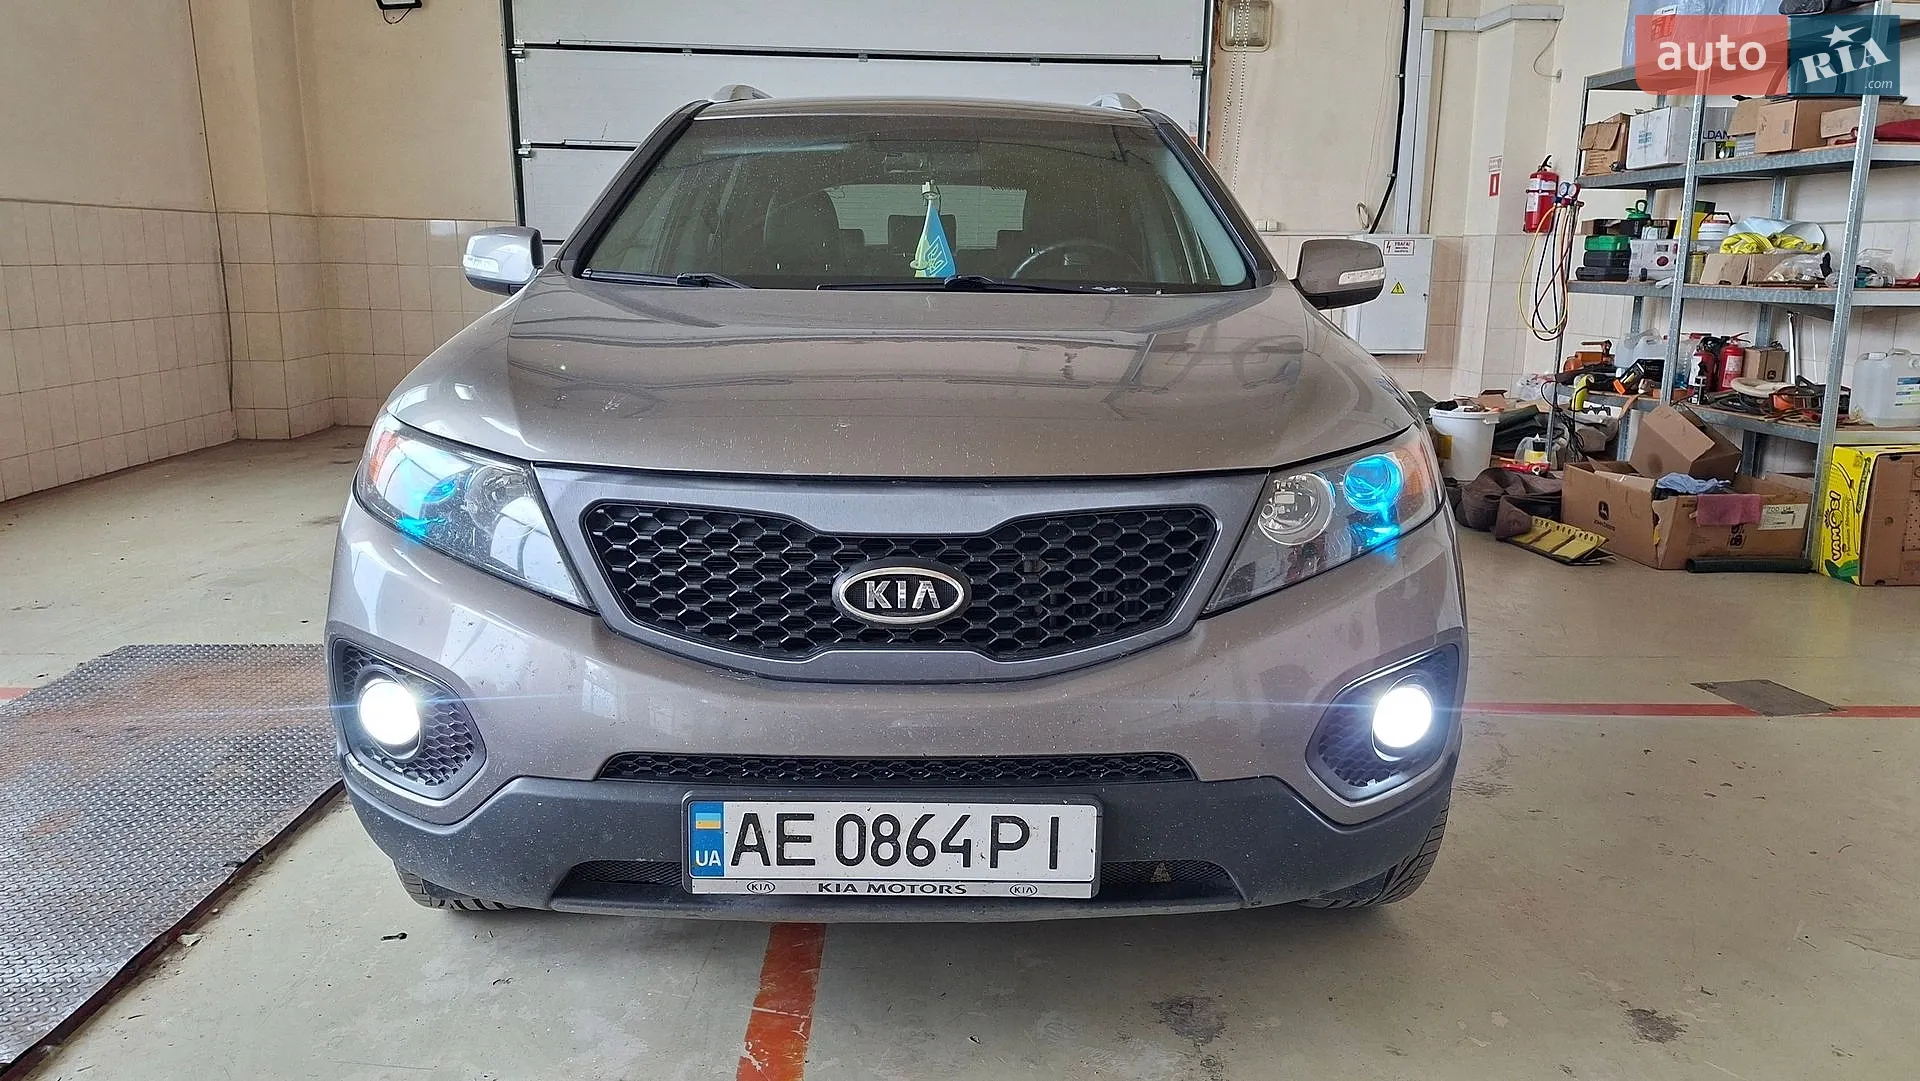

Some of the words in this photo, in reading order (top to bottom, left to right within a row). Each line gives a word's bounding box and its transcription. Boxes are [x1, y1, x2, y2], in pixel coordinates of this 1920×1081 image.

[864, 580, 941, 609] KIA
[730, 813, 816, 867] AE
[835, 813, 972, 868] 0864
[989, 815, 1060, 870] PI
[695, 849, 722, 867] UA
[751, 883, 771, 891] KIA
[818, 882, 859, 893] KIA
[867, 883, 967, 895] MOTORS
[1014, 886, 1034, 894] KIA
